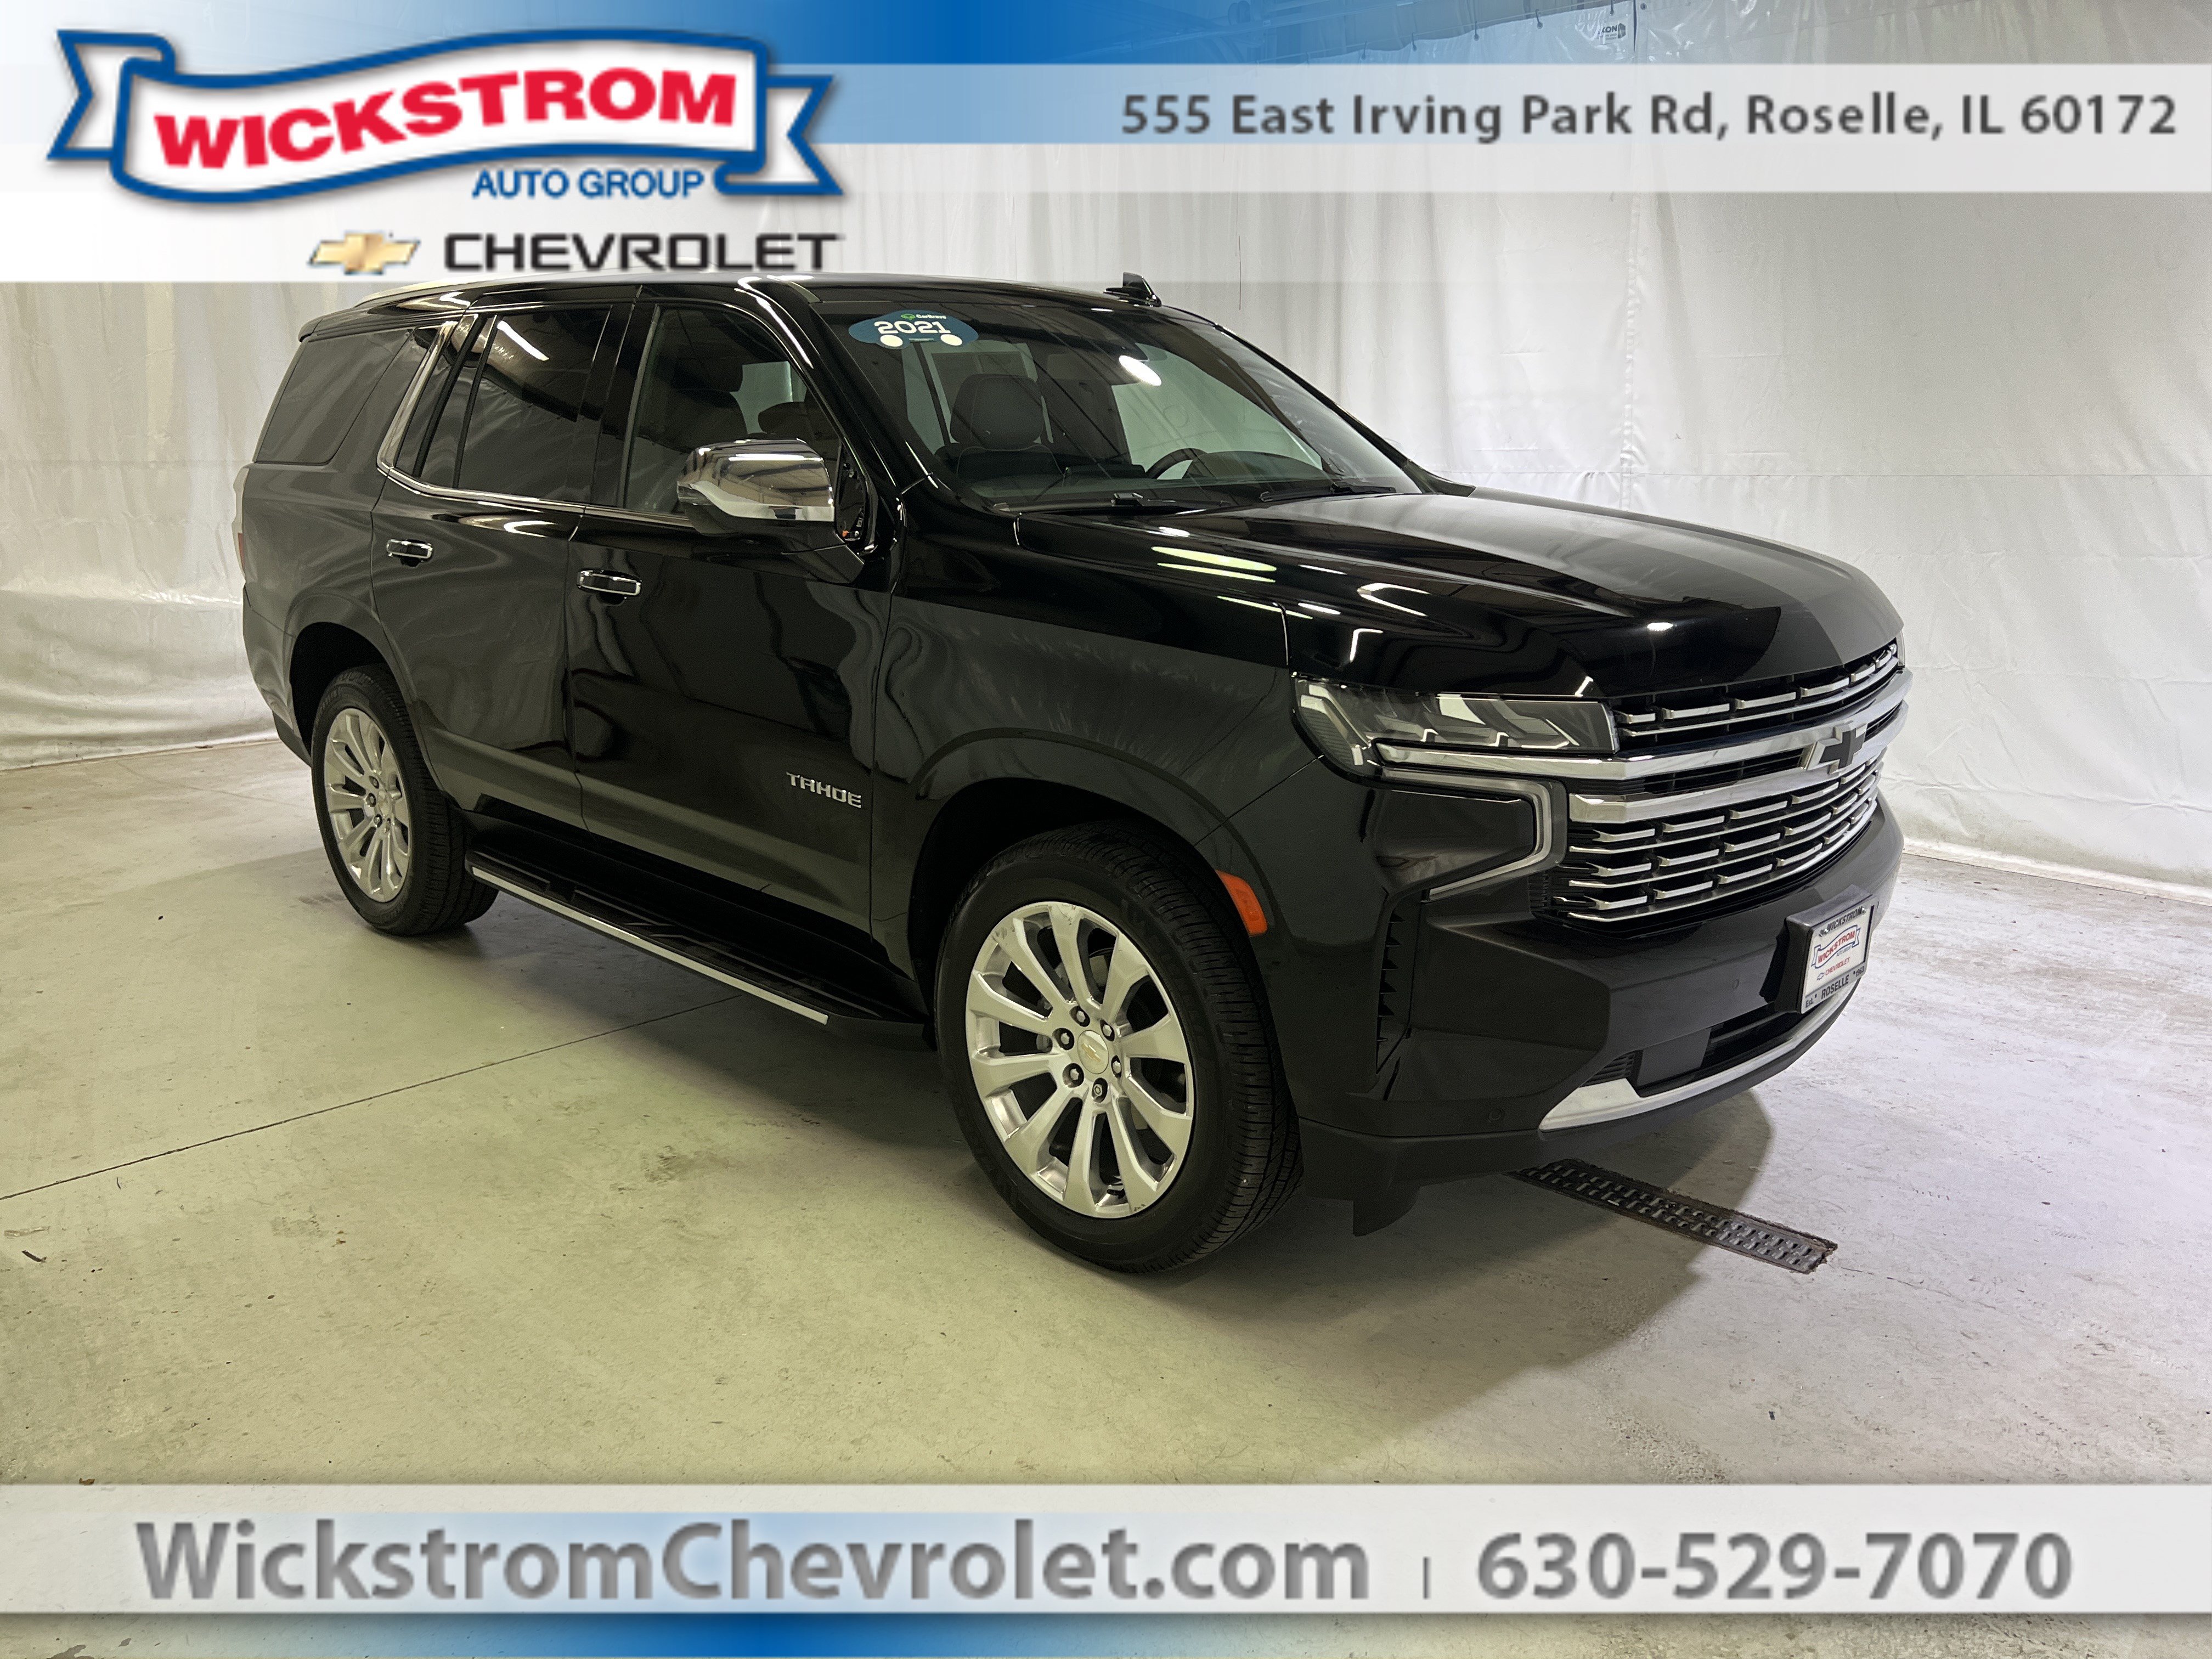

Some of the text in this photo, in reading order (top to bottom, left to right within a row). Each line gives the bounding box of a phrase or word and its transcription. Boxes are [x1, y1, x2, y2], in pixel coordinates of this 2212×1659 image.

[874, 320, 952, 334] 2021
[786, 771, 862, 808] TAHOE
[1827, 906, 1863, 933] WICKSTROM
[1818, 930, 1856, 963] WICKSTROM
[1825, 957, 1850, 975] CHEVROLET
[1821, 974, 1849, 1000] ROSELLE
